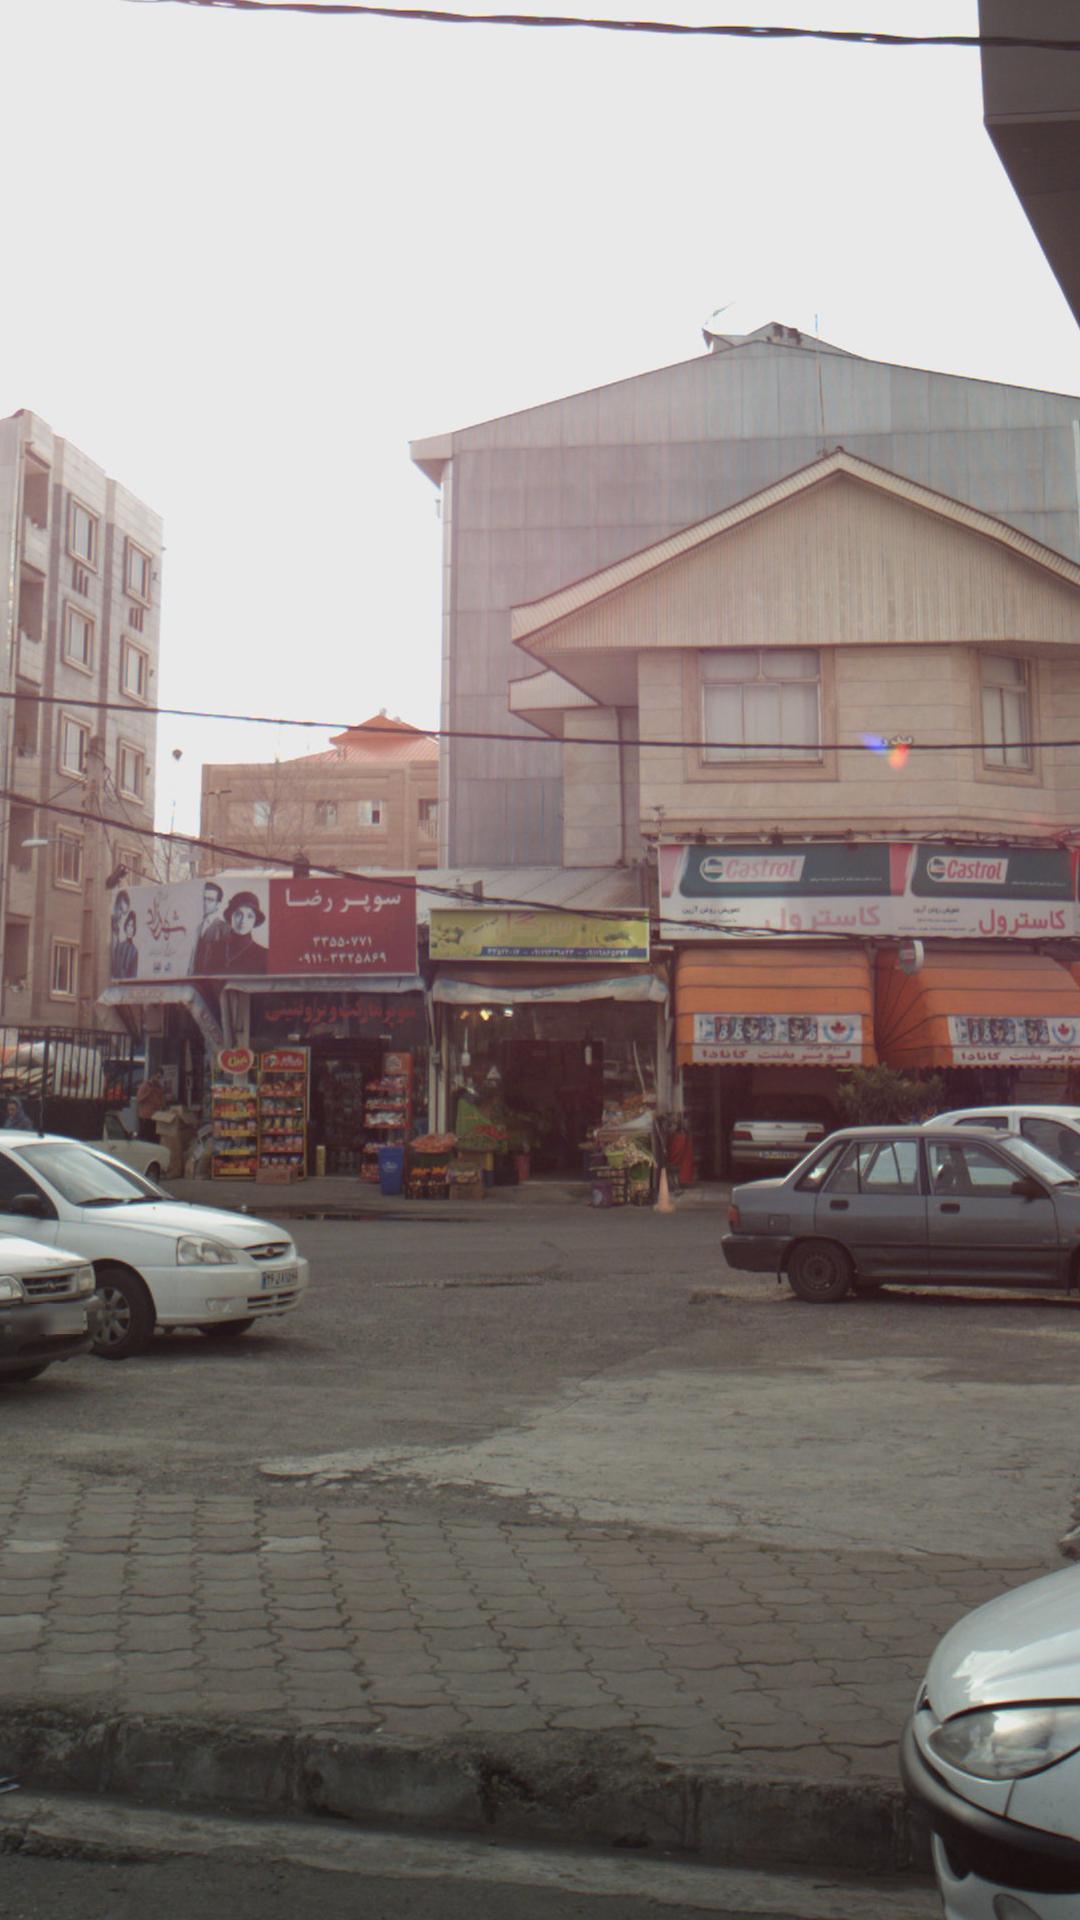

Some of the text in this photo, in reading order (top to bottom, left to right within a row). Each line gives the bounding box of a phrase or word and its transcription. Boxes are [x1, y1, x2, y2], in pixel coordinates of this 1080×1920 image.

[724, 858, 797, 879] Castrol
[947, 859, 1003, 880] Castrol
[285, 887, 401, 913] سوپر رضا
[764, 904, 881, 931] کاسترول
[978, 908, 1067, 936] کاسترول
[702, 1048, 748, 1059] کانادا
[961, 1051, 1001, 1061] کانادا
